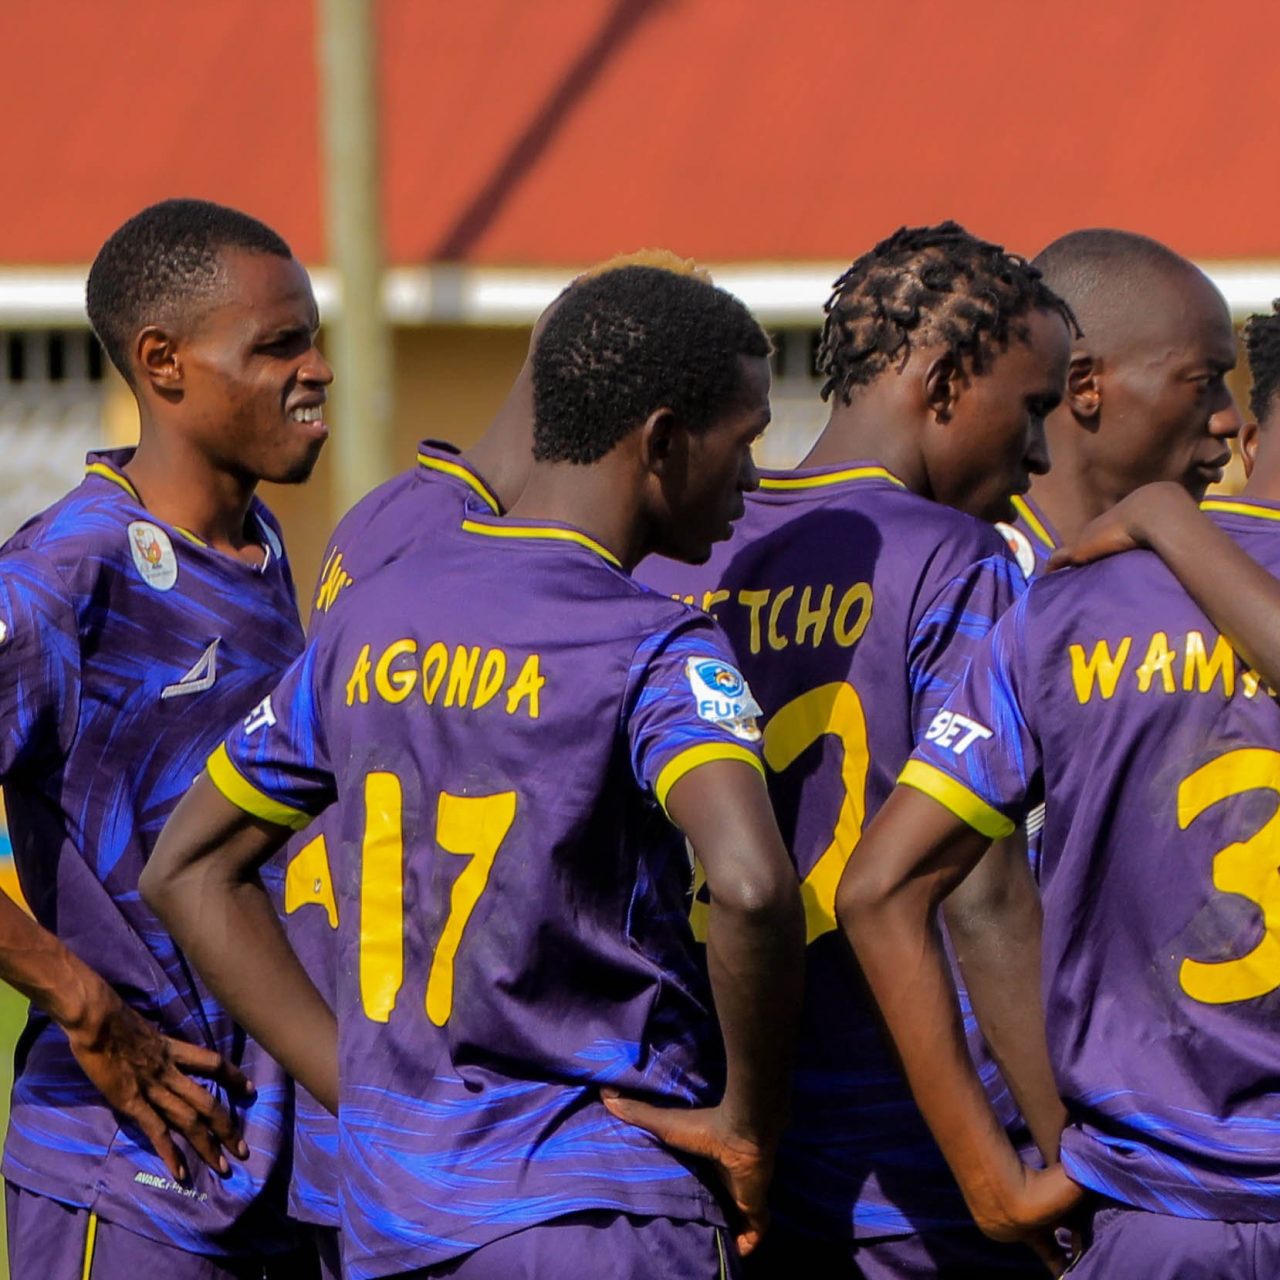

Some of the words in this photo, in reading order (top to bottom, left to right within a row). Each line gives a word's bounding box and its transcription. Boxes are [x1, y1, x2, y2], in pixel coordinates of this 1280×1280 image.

[345, 638, 545, 719] AGONDA
[1068, 629, 1277, 705] WAM
[924, 708, 994, 755] BET
[359, 770, 518, 1028] 17
